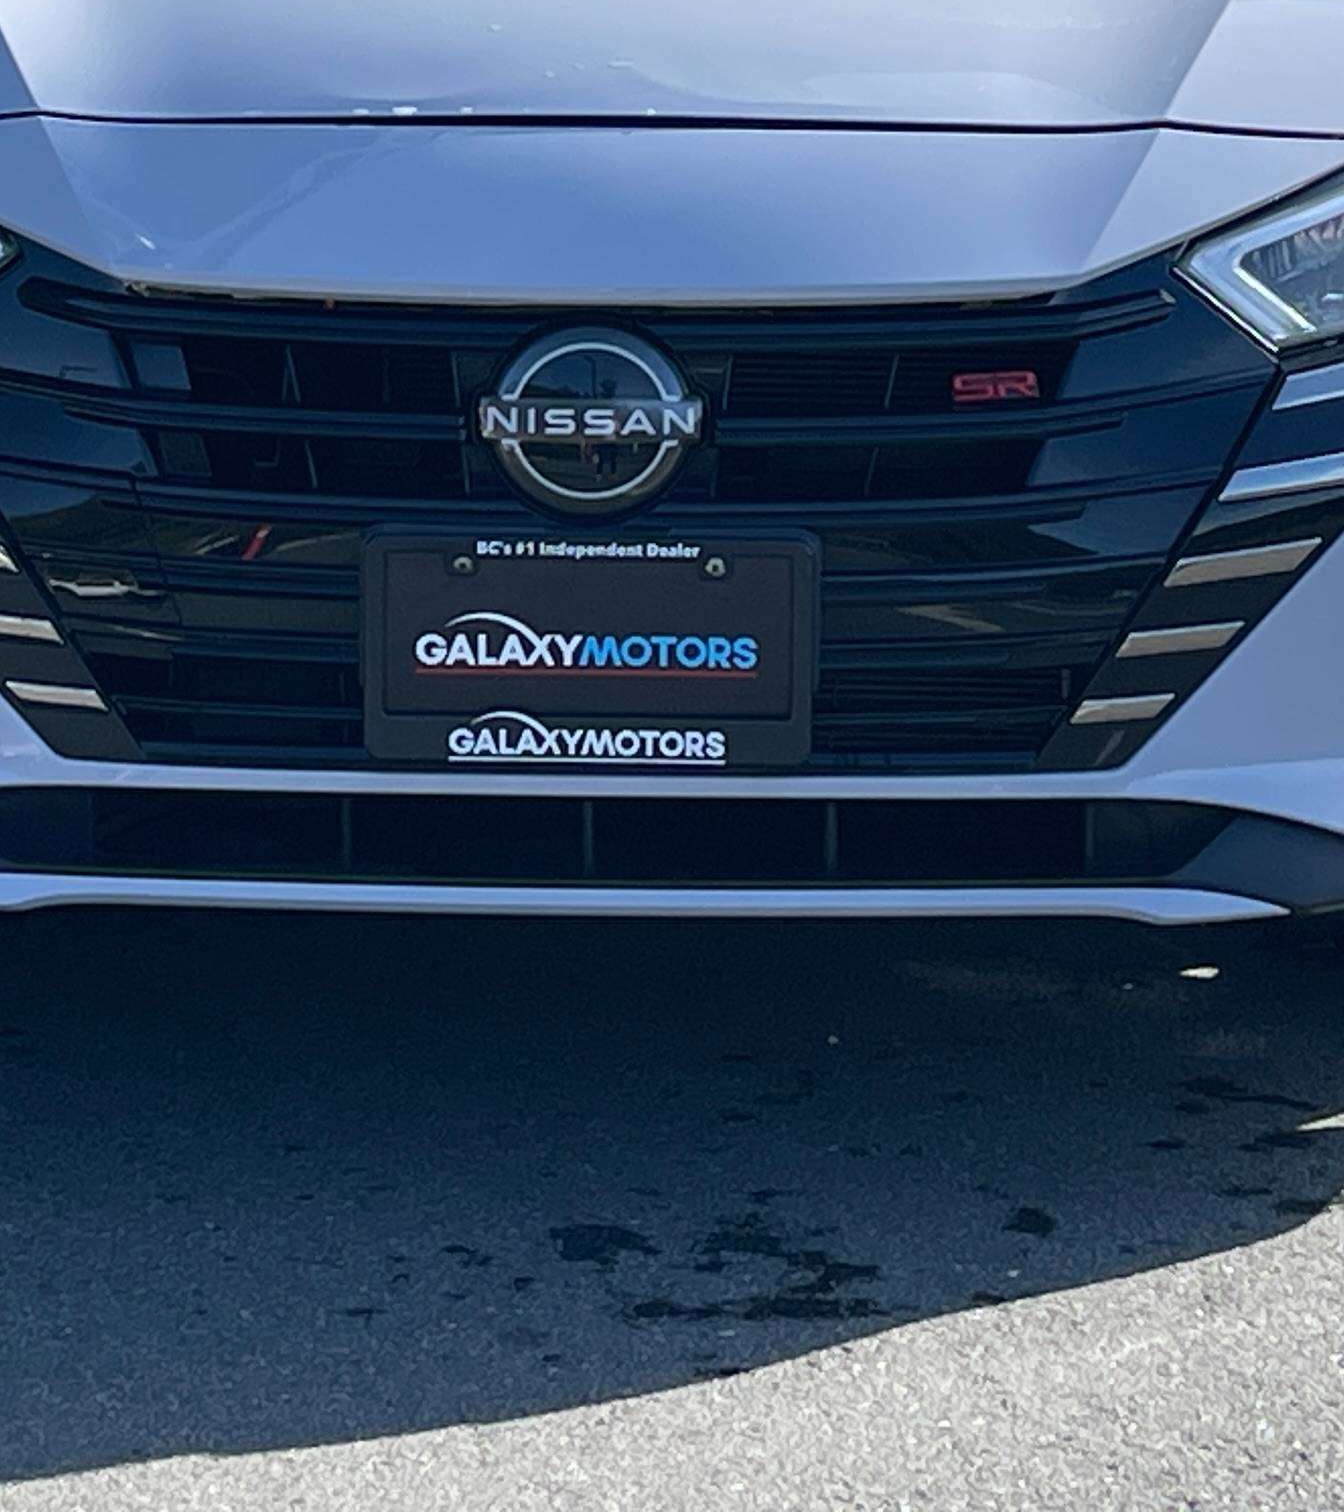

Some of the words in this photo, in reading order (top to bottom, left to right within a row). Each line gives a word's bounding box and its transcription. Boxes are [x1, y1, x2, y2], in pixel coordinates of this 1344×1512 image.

[952, 370, 1039, 402] SR
[485, 406, 695, 436] NISSAN
[475, 540, 512, 556] BC's
[514, 541, 535, 556] #1
[538, 541, 643, 560] Independent
[646, 542, 701, 558] Dealer
